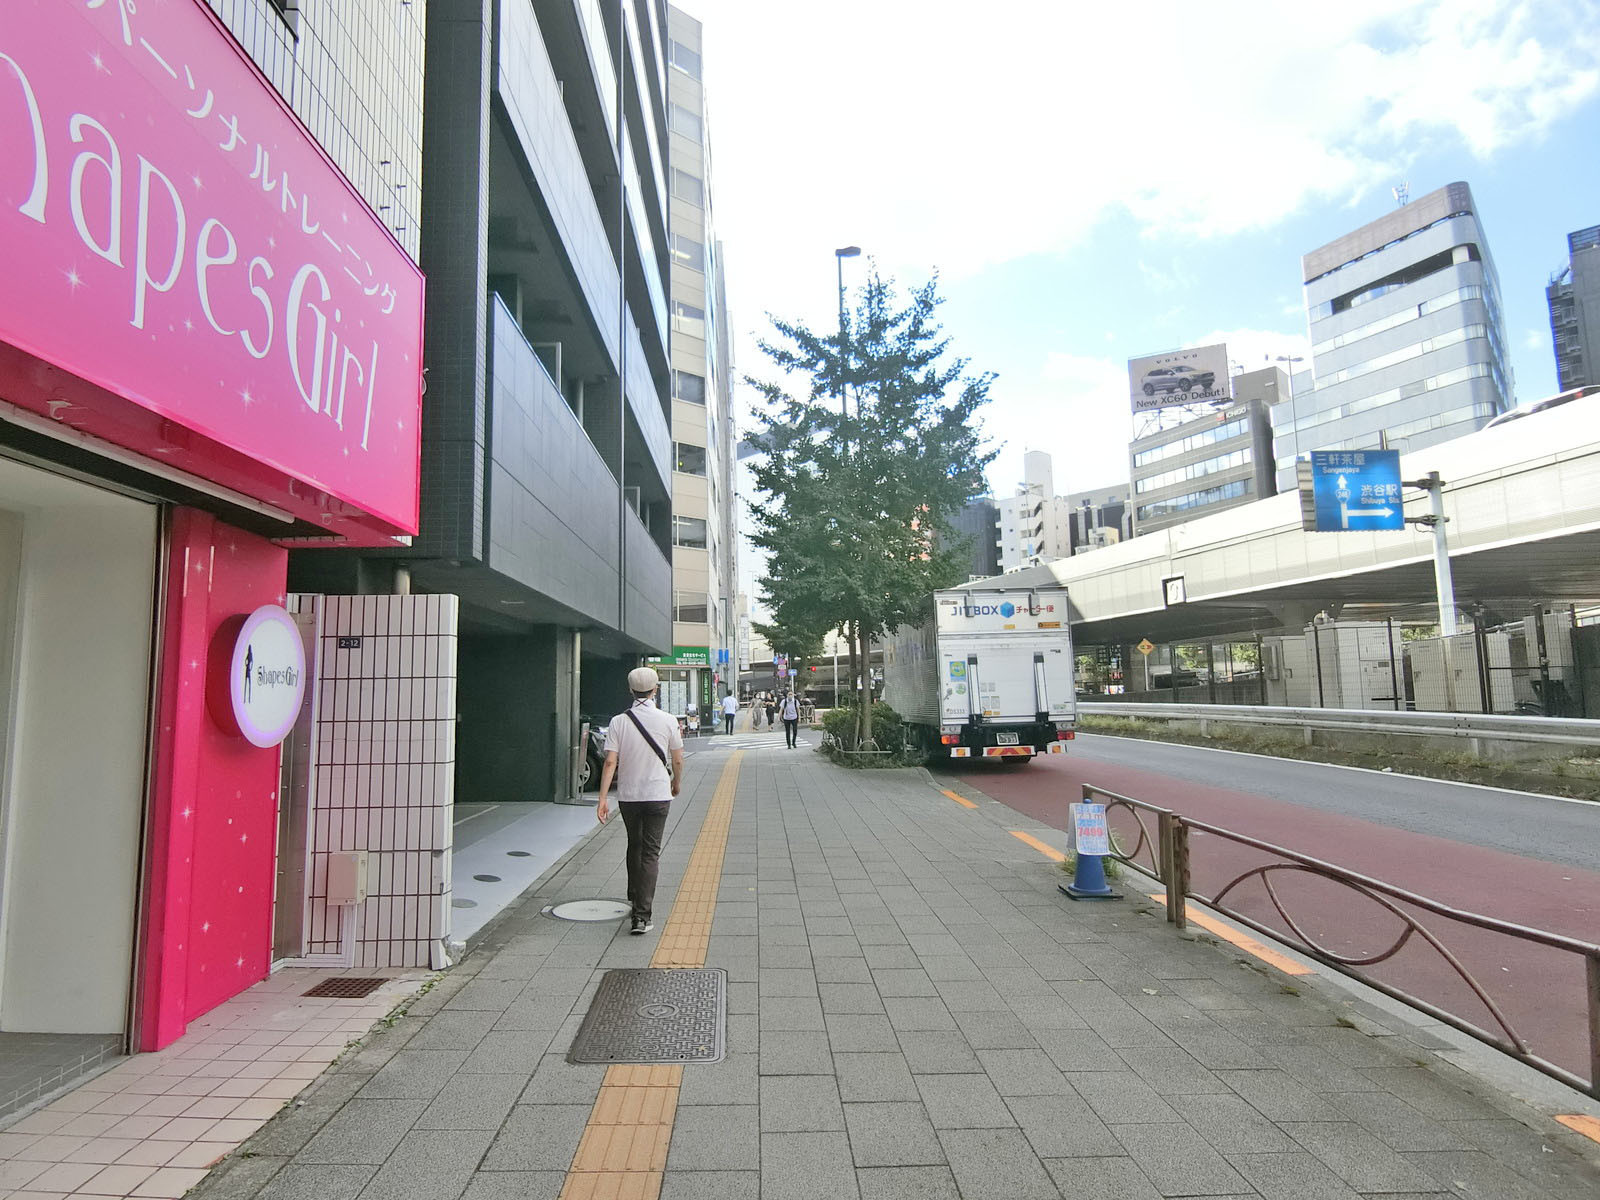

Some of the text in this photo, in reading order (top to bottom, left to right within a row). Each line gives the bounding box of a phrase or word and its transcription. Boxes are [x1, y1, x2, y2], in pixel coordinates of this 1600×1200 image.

[1156, 353, 1197, 363] VOLVO
[1136, 398, 1158, 408] New
[1160, 393, 1188, 404] XC60
[1316, 453, 1365, 465] 三軒茶屋
[1361, 484, 1398, 496] 渋谷駅
[1360, 497, 1386, 505] Shibuya
[951, 605, 999, 616] JITBOX
[340, 639, 359, 647] 2-12
